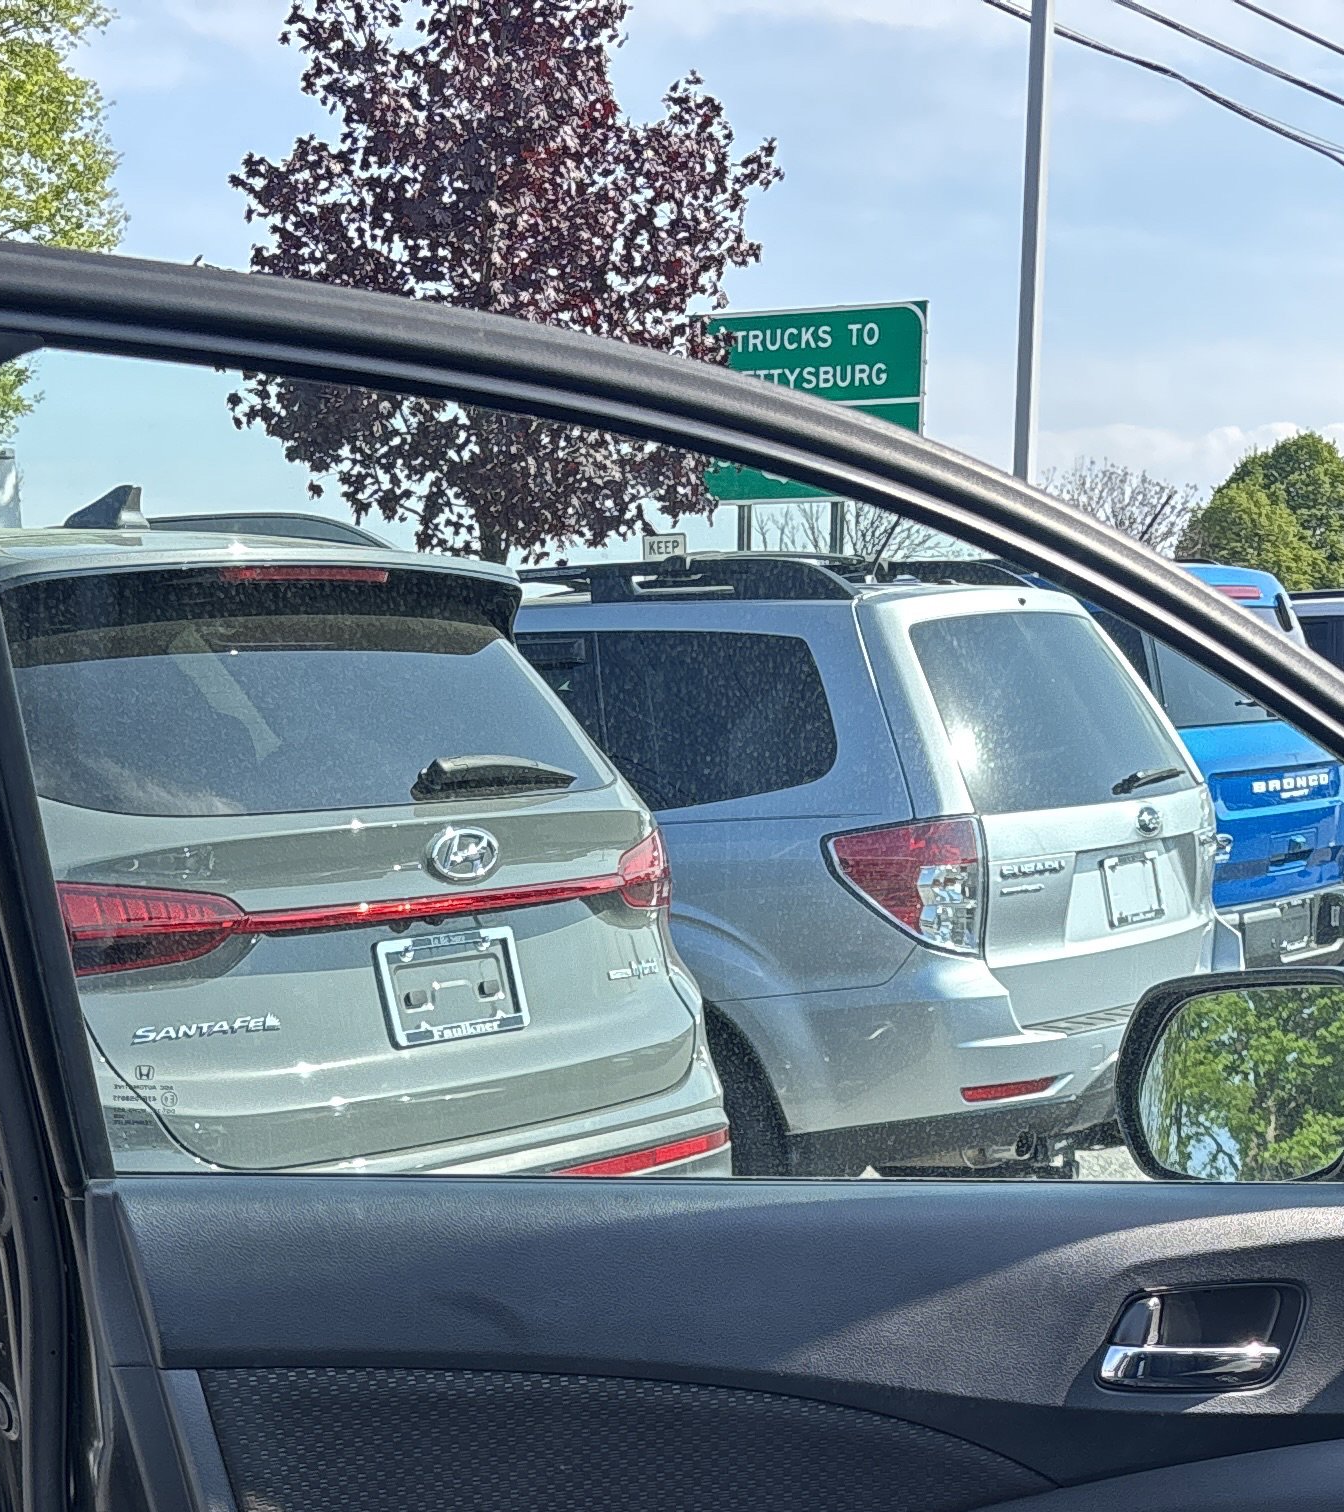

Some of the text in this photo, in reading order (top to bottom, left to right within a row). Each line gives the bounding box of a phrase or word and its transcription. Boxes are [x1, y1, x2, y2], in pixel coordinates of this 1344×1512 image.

[734, 322, 880, 353] TRUCKS TO
[648, 539, 680, 556] KEEP
[1251, 773, 1329, 794] BRONCO
[432, 1020, 501, 1041] Faulkner
